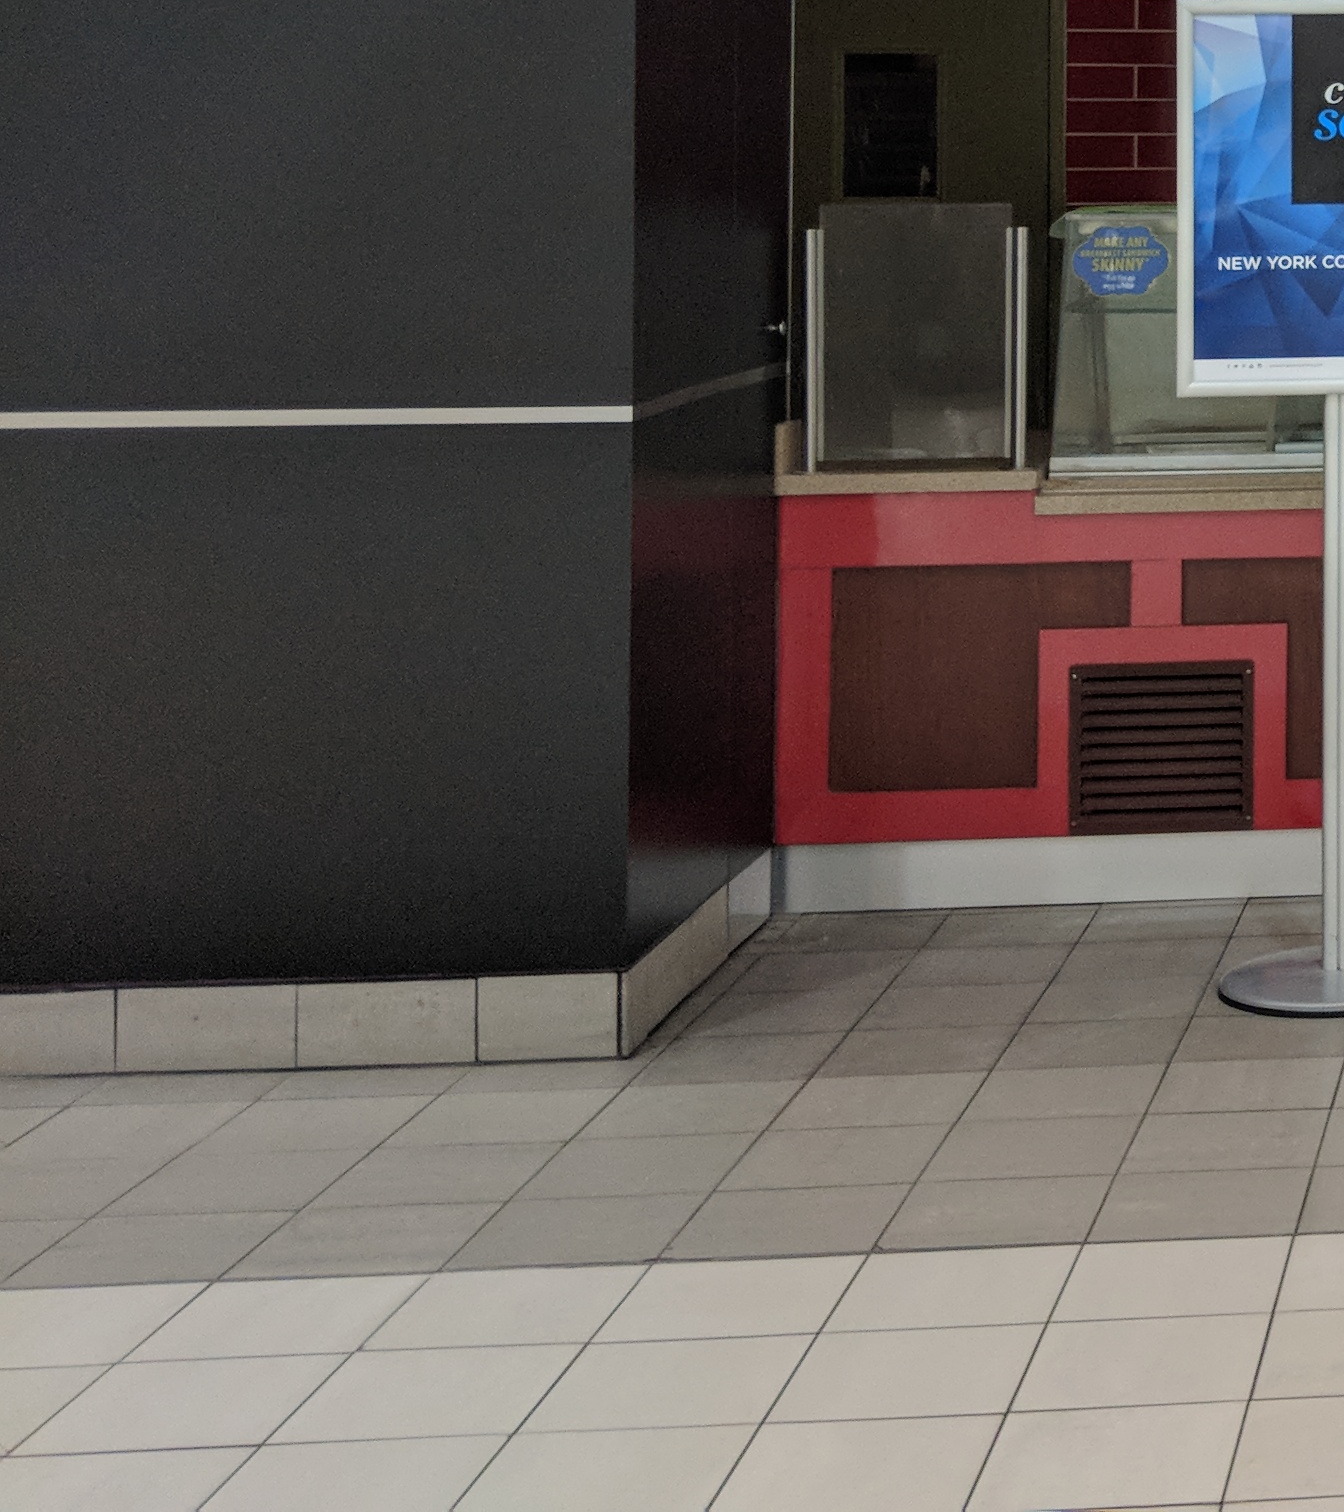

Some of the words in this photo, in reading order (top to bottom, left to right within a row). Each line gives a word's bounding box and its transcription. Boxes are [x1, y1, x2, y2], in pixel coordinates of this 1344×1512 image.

[1094, 236, 1124, 248] MAKE
[1126, 236, 1149, 248] ANY
[1217, 255, 1262, 271] NEW
[1266, 254, 1317, 270] YORK
